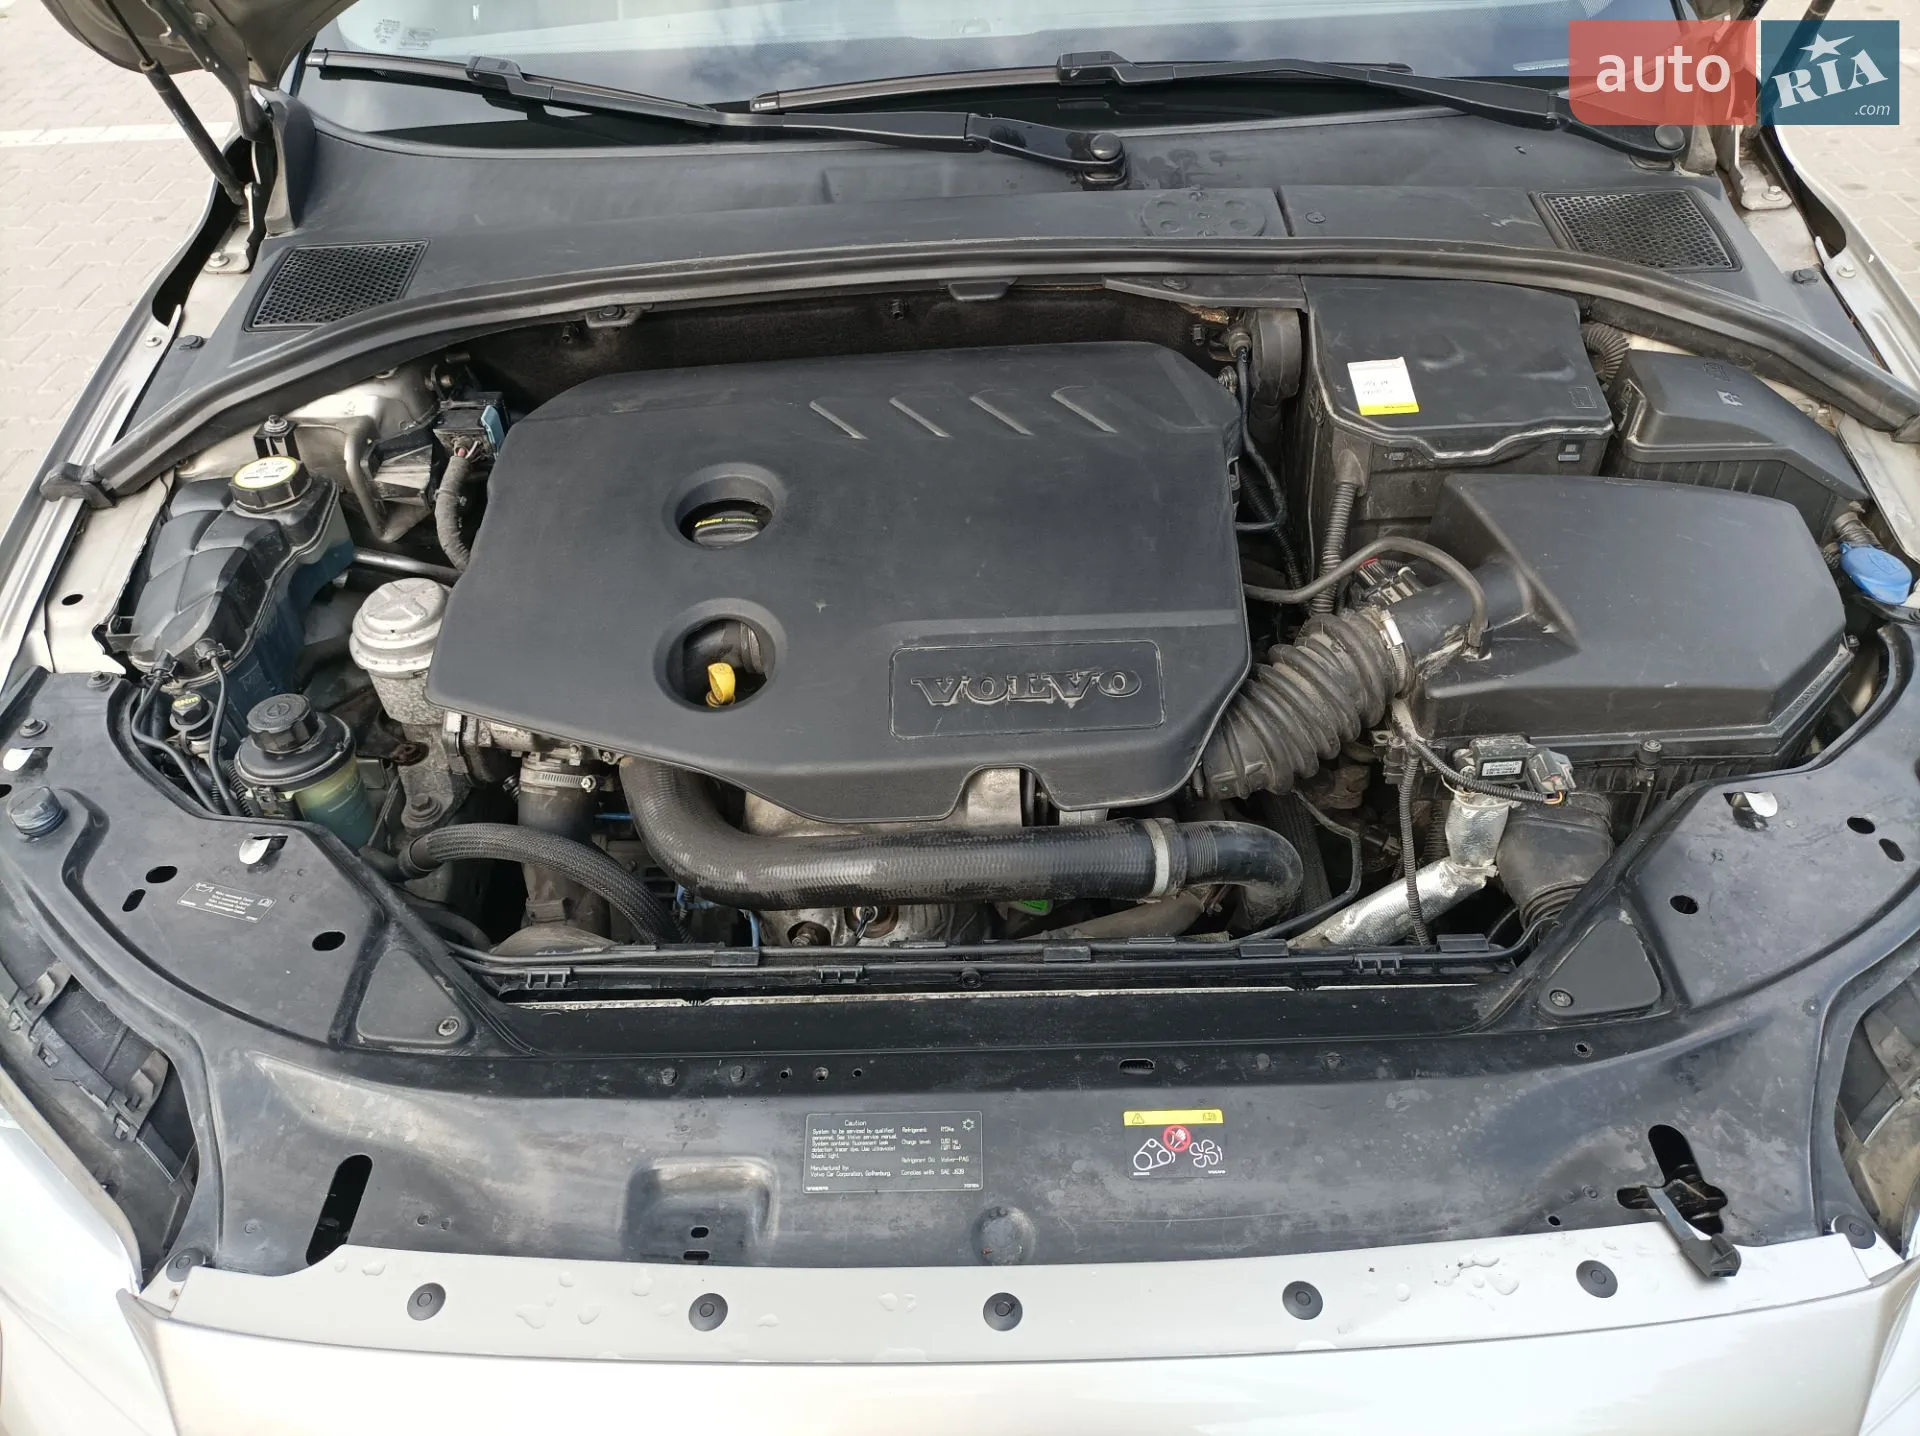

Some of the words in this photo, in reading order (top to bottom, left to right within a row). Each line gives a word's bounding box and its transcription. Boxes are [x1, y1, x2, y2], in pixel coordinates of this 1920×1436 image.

[910, 670, 1143, 708] VOLVO
[844, 1119, 867, 1127] Caution
[812, 1128, 830, 1136] System
[866, 1127, 873, 1135] by
[874, 1127, 895, 1135] qualified
